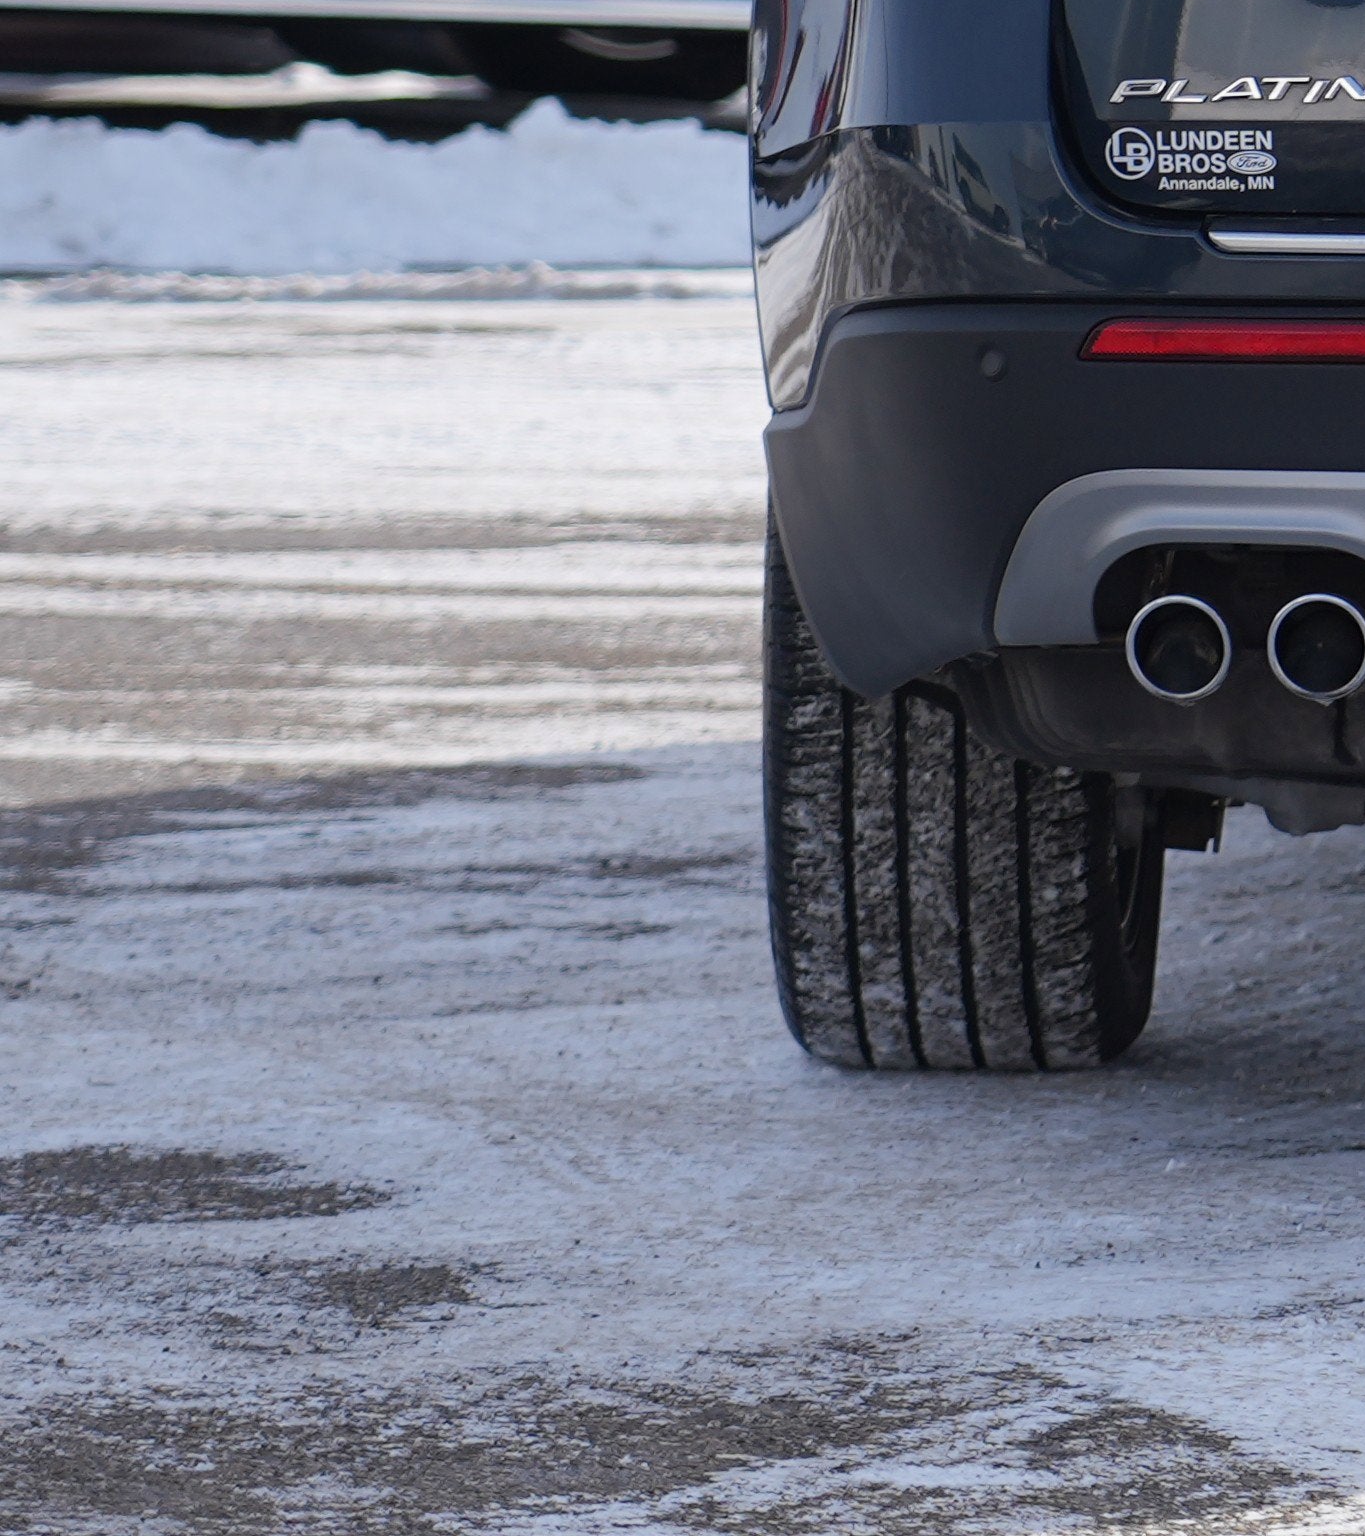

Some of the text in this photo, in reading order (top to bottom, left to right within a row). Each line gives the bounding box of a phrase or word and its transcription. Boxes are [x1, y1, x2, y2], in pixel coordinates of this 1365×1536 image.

[1156, 130, 1273, 151] LUNDEEN
[1158, 153, 1227, 174] BROS
[1157, 176, 1275, 192] Annandale, MN
